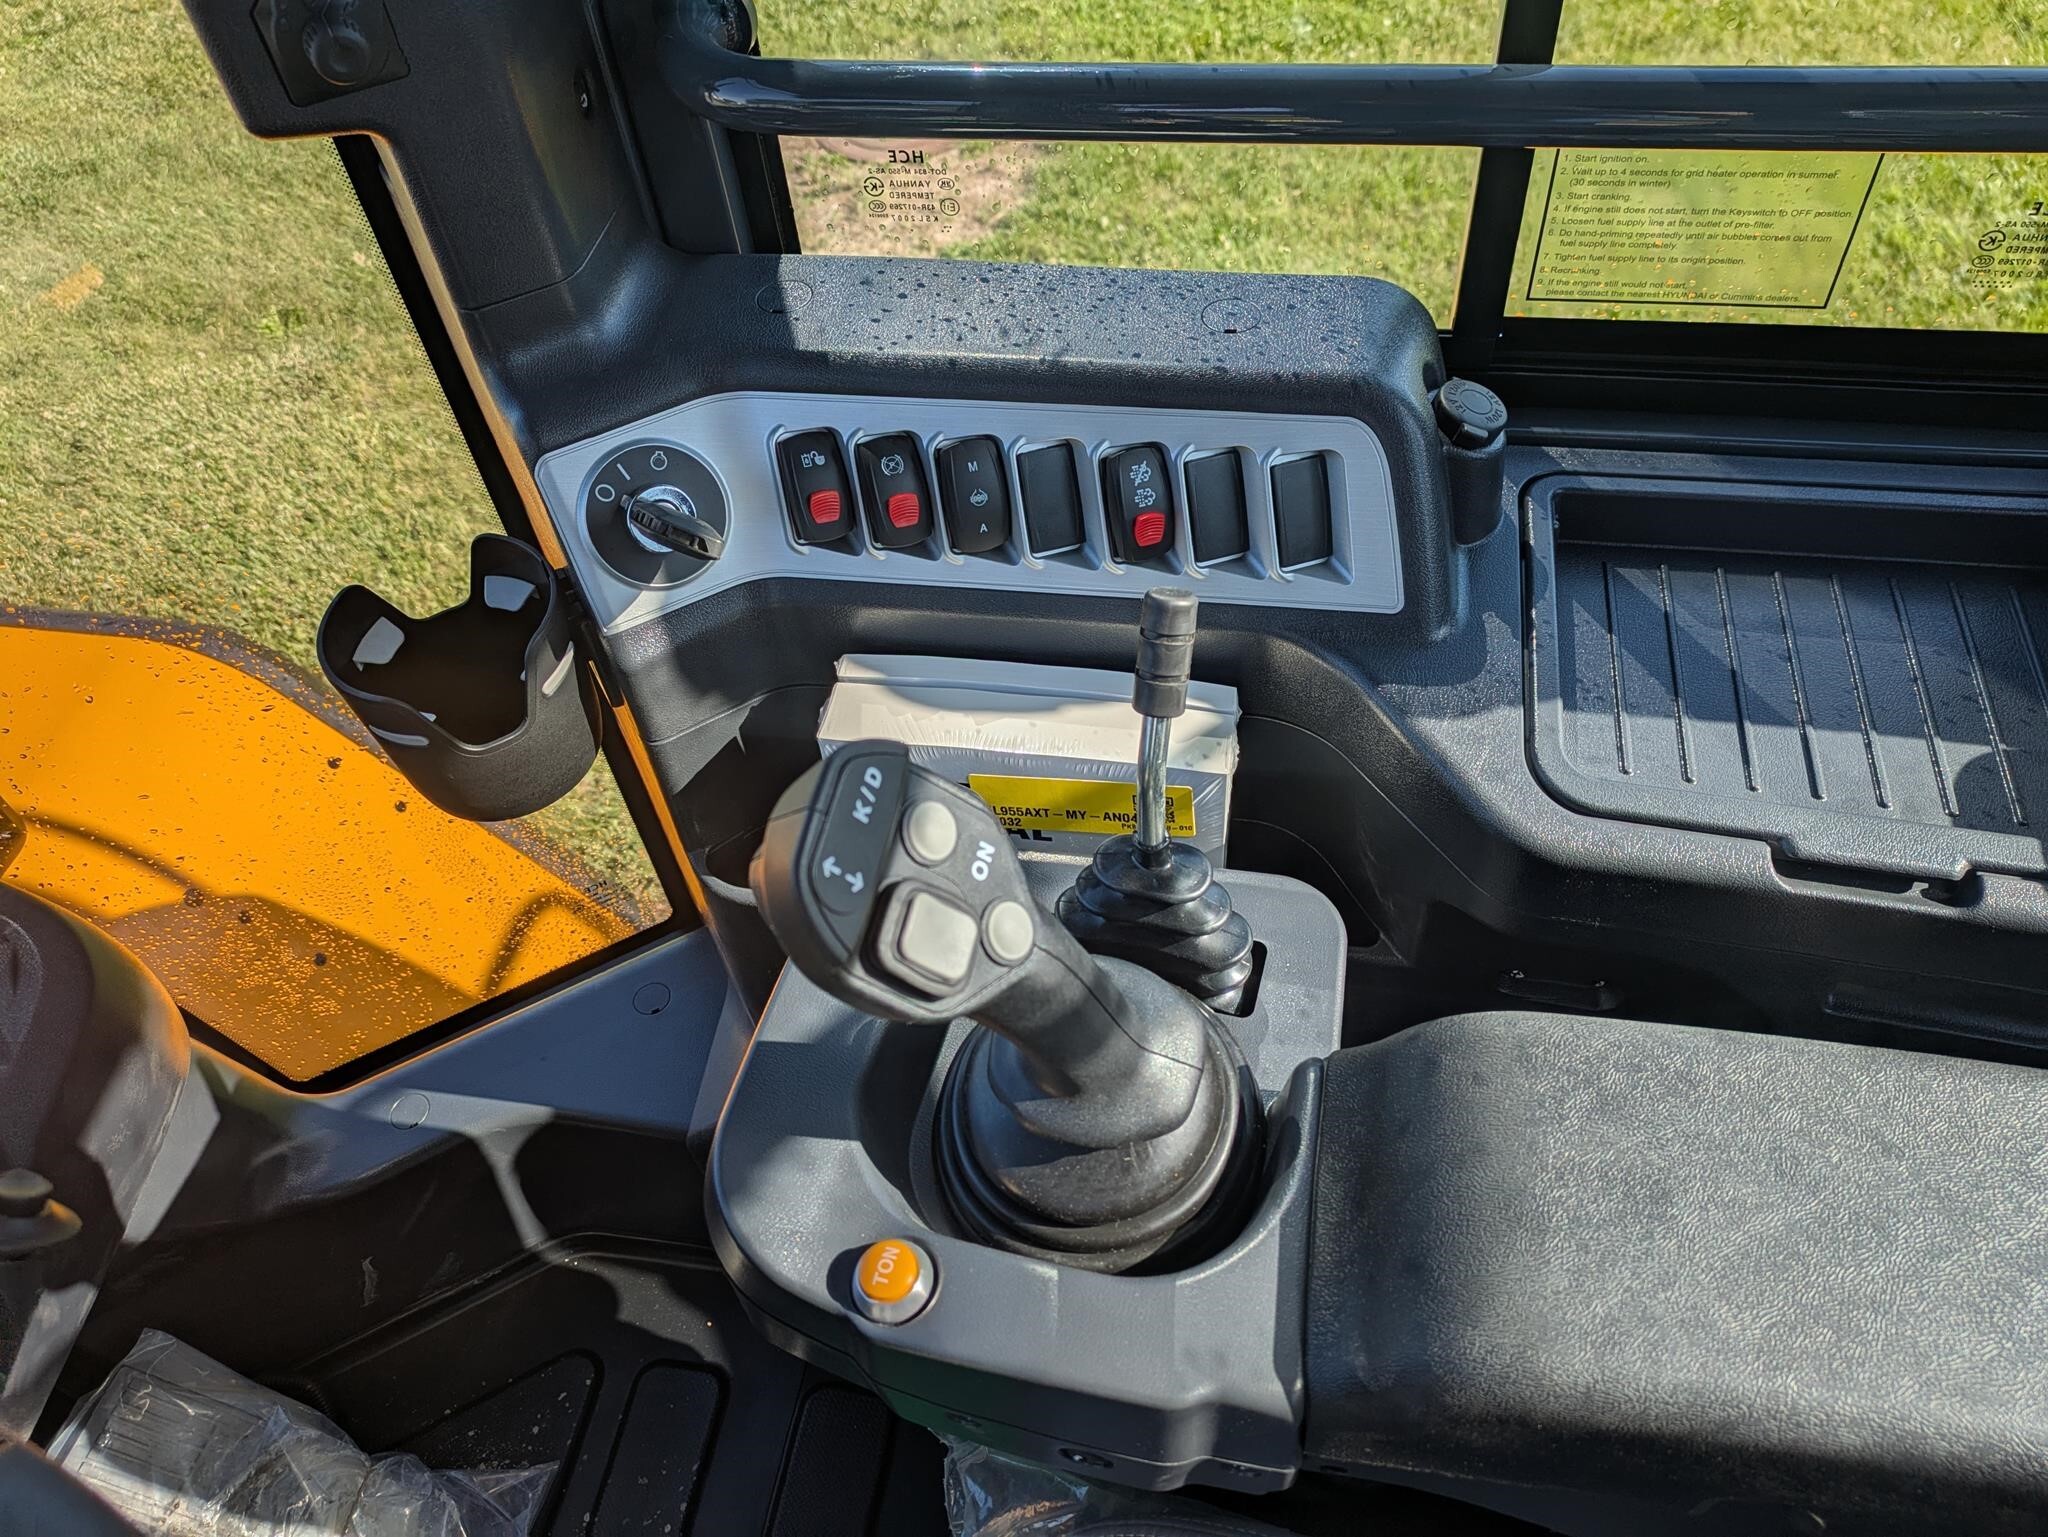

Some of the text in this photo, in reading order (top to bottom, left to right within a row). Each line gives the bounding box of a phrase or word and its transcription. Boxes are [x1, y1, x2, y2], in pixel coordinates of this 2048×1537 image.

[1575, 155, 1597, 163] Start
[1599, 155, 1632, 164] ignition
[1573, 167, 1592, 176] Wait
[1595, 169, 1605, 177] up
[1609, 168, 1618, 176] to
[1629, 168, 1668, 176] seconds
[1671, 168, 1684, 177] for
[1686, 169, 1704, 178] grid
[1706, 170, 1737, 178] heater
[1740, 171, 1784, 179] operation
[1569, 179, 1584, 187] (30
[1587, 179, 1625, 187] seconds
[1639, 180, 1671, 189] winter)
[1556, 192, 1632, 202] 3. Start cranking.
[1564, 205, 1570, 213] If
[1573, 205, 1603, 215] engine
[1606, 206, 1621, 214] still
[1666, 208, 1687, 216] start,
[1729, 209, 1776, 218] Keyswitch
[1779, 209, 1788, 217] to
[1814, 210, 1853, 219] position.
[1551, 217, 1558, 225] 5.
[1598, 218, 1613, 226] fuel
[1617, 219, 1646, 228] supply
[1649, 218, 1664, 226] line
[1679, 219, 1693, 227] the
[1696, 221, 1722, 229] outlet
[1724, 221, 1733, 229] of
[1735, 222, 1775, 231] pre-filter.
[1575, 230, 1632, 239] hand-priming
[1635, 232, 1683, 240] repeatedly
[1686, 232, 1704, 240] until
[1722, 233, 1756, 241] bubbles
[1793, 234, 1809, 242] out
[1811, 234, 1832, 242] from
[1578, 240, 1608, 249] supply
[1610, 240, 1625, 248] line
[1554, 253, 1586, 262] Tighten
[1589, 253, 1605, 261] fuel
[1608, 255, 1636, 263] supply
[1639, 254, 1654, 262] line
[1658, 255, 1666, 263] to
[1668, 255, 1678, 263] its
[1681, 256, 1706, 265] origin
[1708, 256, 1746, 266] position.
[1572, 281, 1601, 289] engine
[1621, 281, 1647, 289] would
[1546, 288, 1575, 296] please
[1577, 289, 1608, 297] contact
[1662, 291, 1707, 299] HYUNDAI
[1721, 293, 1763, 301] Cummins
[1765, 294, 1801, 302] dealers.
[967, 461, 978, 472] M
[980, 523, 988, 533] A
[853, 767, 884, 825] K/D
[972, 841, 995, 882] ON
[872, 1247, 900, 1285] TON
